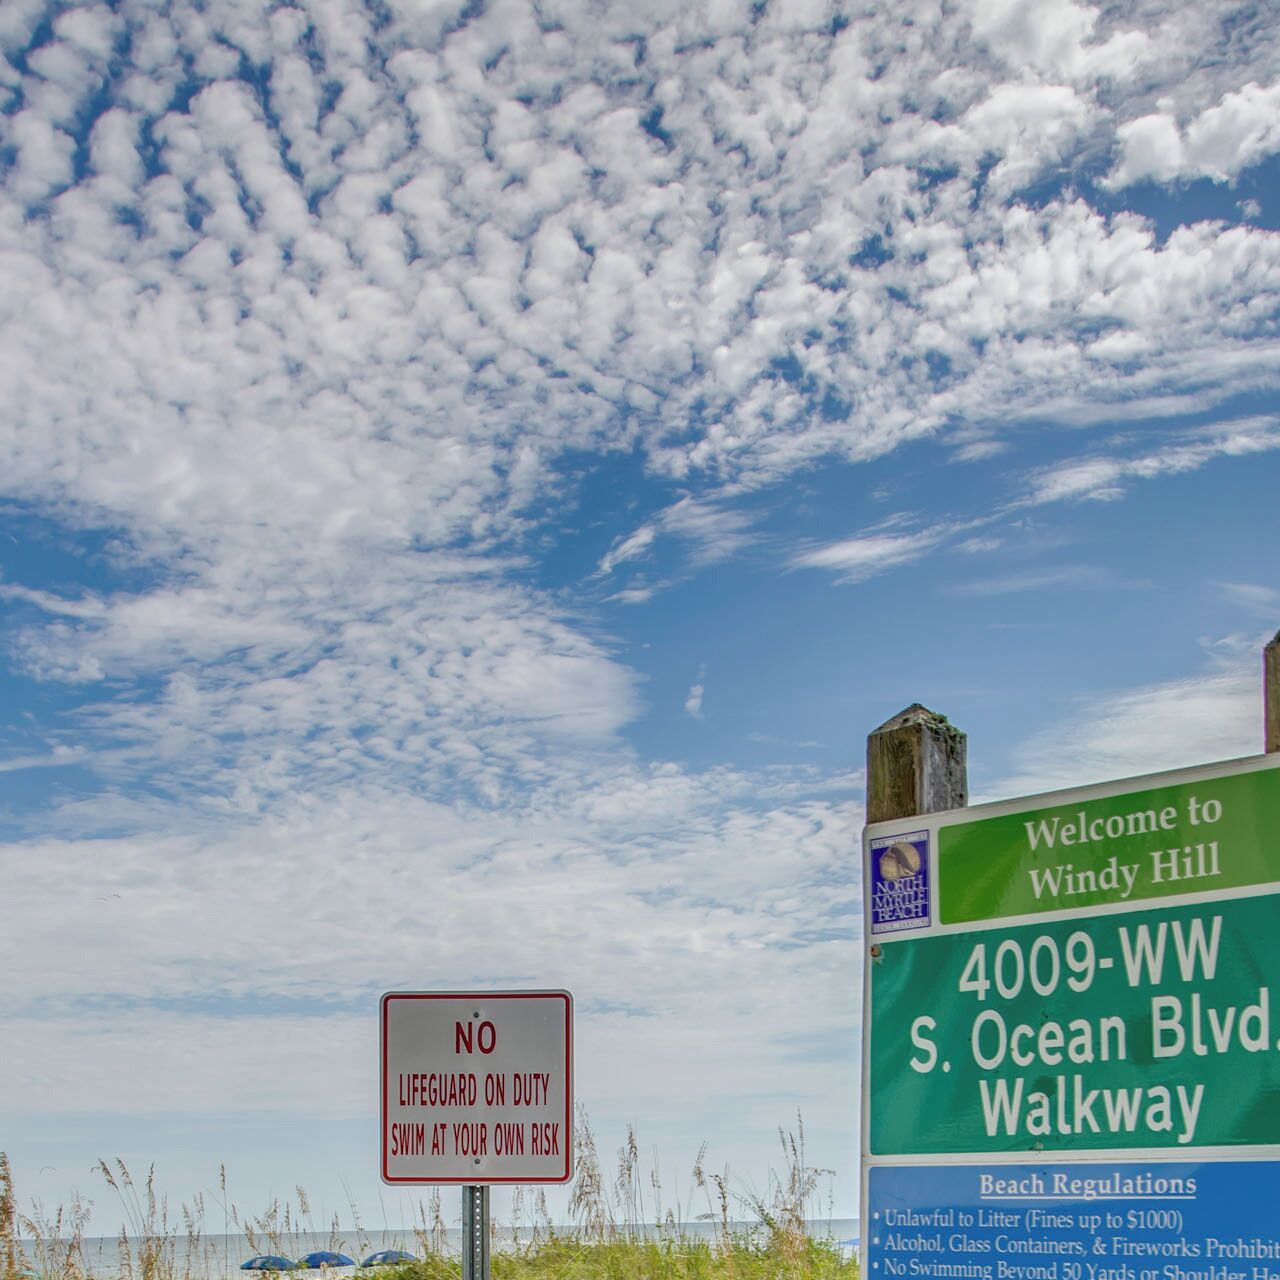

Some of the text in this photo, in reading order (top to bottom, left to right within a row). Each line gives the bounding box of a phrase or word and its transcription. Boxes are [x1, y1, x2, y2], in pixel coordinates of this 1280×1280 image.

[1023, 795, 1223, 852] Welcome to
[877, 875, 923, 895] NORTH
[1027, 840, 1222, 899] Windy Hill
[872, 887, 928, 911] MYRTLE
[878, 903, 923, 922] BEACH
[958, 914, 1223, 1000] 4009-WW
[455, 1020, 496, 1054] NO
[909, 1014, 951, 1073] S.
[971, 1008, 1126, 1070] Ocean
[399, 1072, 550, 1106] LIFEGUARD ON DUTY
[977, 1074, 1206, 1144] Walkway
[391, 1121, 559, 1156] SWIM AT YOUR OWN RISK
[979, 1172, 1196, 1200] Beach Regulations
[884, 1209, 1184, 1235] Unlawful to Litter (Fines up to $1000)
[883, 1232, 945, 1253] Alcohol,
[948, 1233, 991, 1252] Glass
[994, 1234, 1088, 1256] Containers,
[1091, 1235, 1107, 1255] &
[1111, 1235, 1201, 1257] Fireworks
